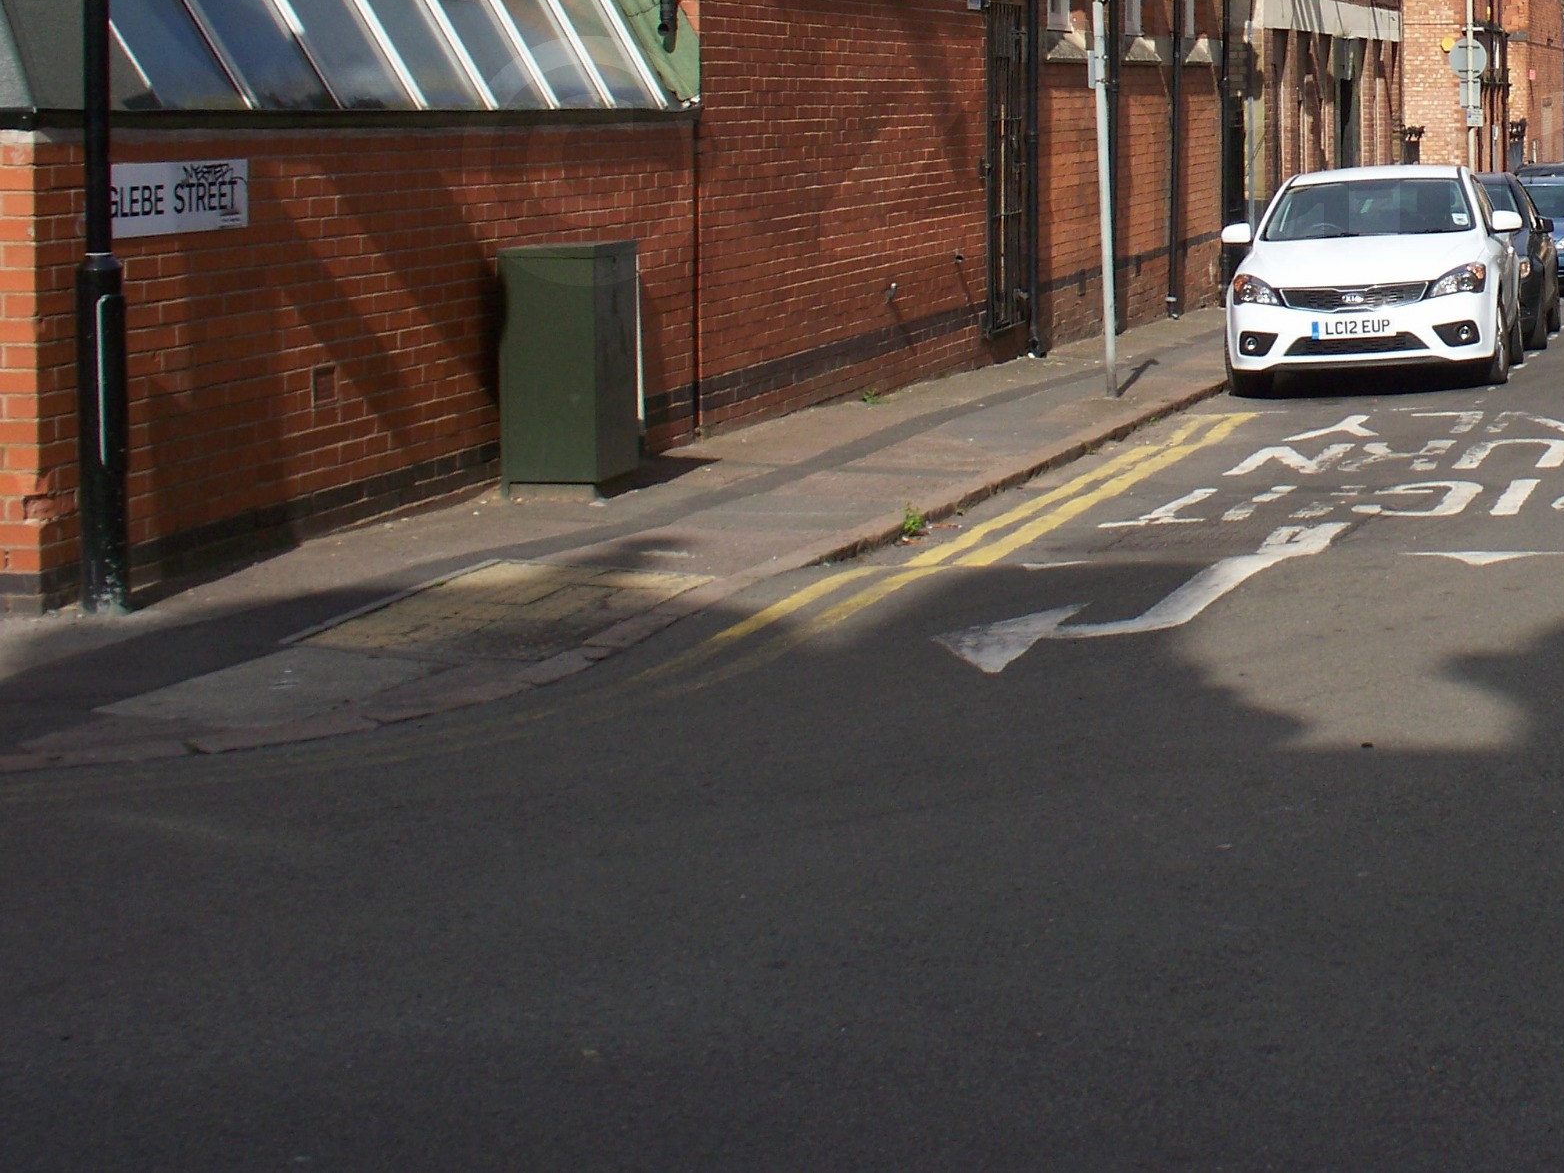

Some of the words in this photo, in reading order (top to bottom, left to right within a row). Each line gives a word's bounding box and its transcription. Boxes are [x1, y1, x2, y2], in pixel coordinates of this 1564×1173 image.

[110, 184, 164, 218] GLEBE
[173, 179, 238, 214] STREET
[1325, 320, 1357, 335] LC12
[1361, 319, 1390, 333] EUP
